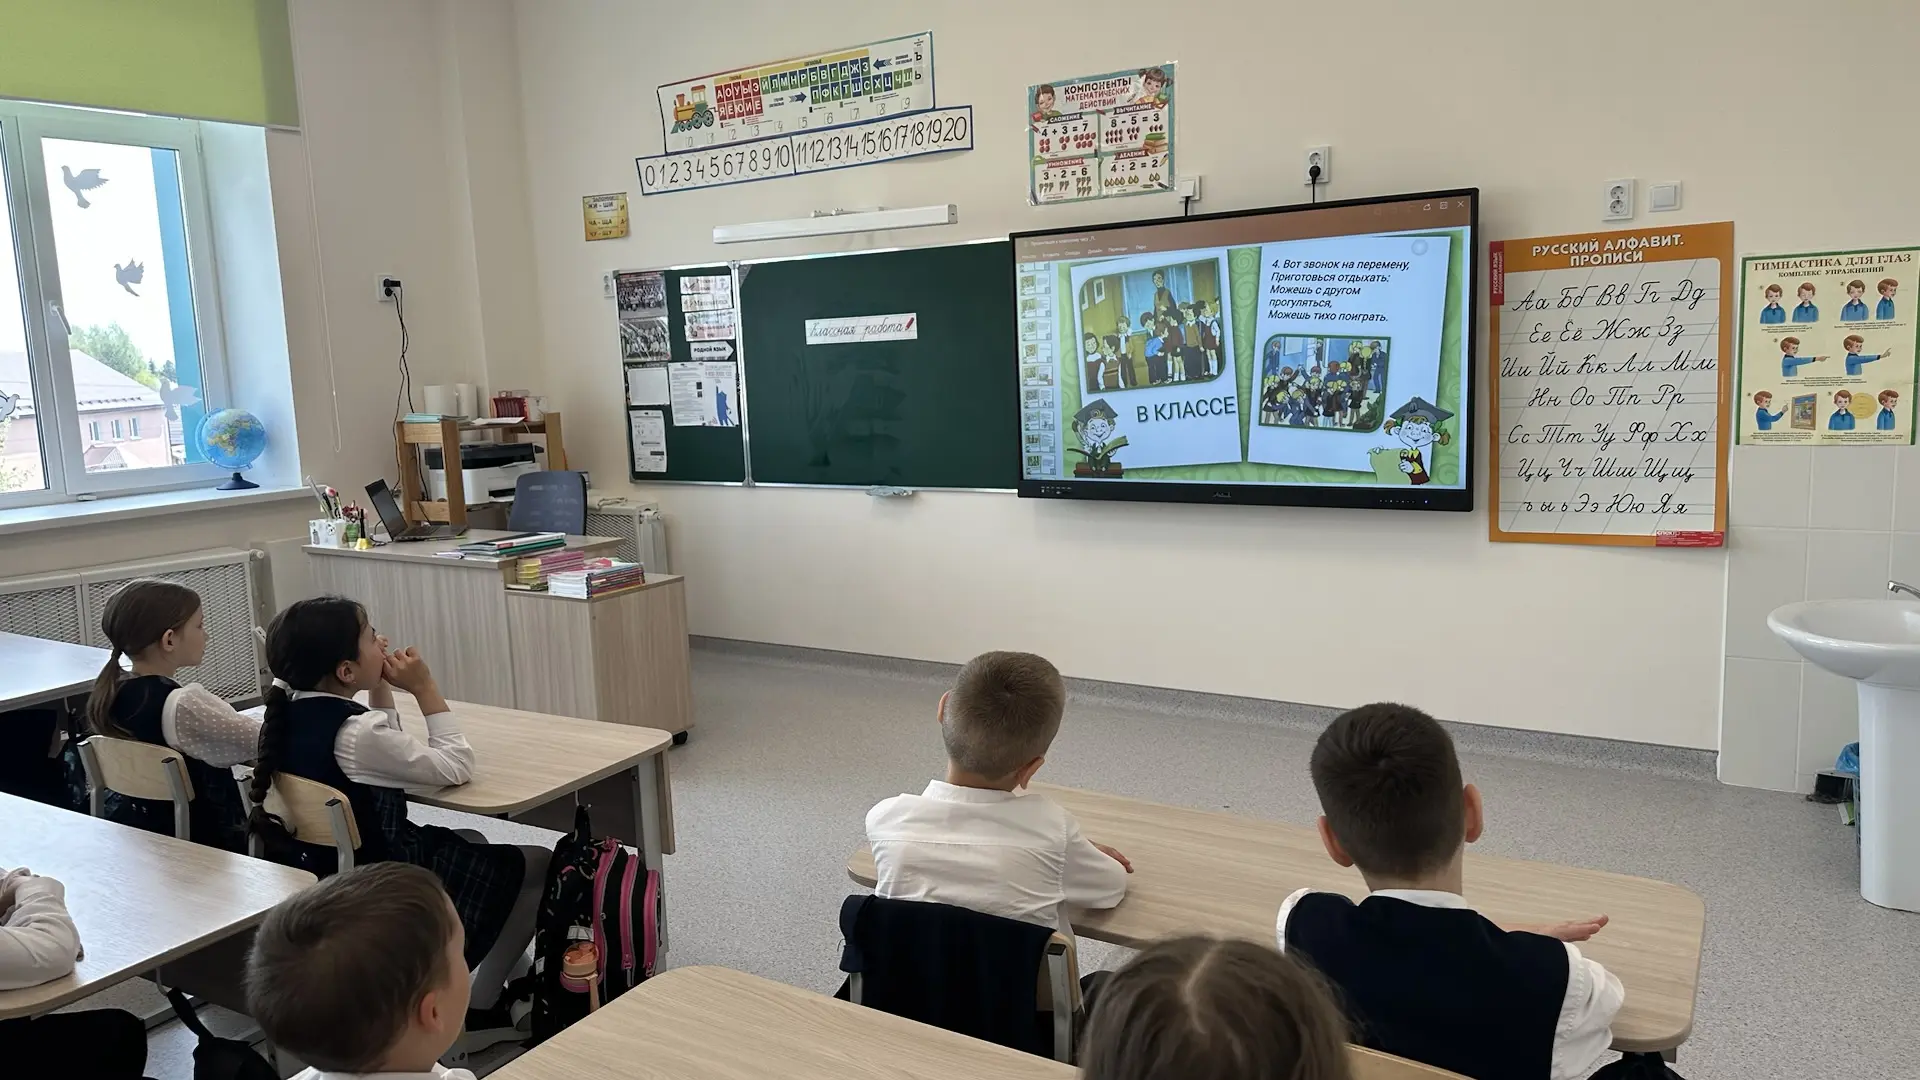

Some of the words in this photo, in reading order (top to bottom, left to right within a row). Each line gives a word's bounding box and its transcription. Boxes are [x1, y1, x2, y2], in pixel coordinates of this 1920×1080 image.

[717, 90, 723, 98] А
[725, 88, 732, 97] О
[734, 86, 740, 95] У
[743, 84, 750, 94] Ы
[753, 83, 759, 92] Э
[772, 79, 778, 89] Л
[781, 77, 788, 86] М
[790, 75, 797, 85] Н
[801, 74, 806, 83] Р
[810, 72, 817, 81] Б
[821, 70, 827, 79] В
[830, 68, 836, 77] Г
[842, 67, 849, 77] Д
[850, 64, 859, 74] Ж
[862, 62, 868, 72] З
[1065, 78, 1131, 95] КОМПОНЕНТЫ
[719, 107, 725, 116] Я
[736, 104, 743, 112] Ю
[746, 102, 752, 111] И
[755, 101, 761, 110] Е
[812, 90, 818, 100] П
[822, 88, 829, 97] Ф
[832, 87, 838, 96] К
[843, 85, 849, 94] Т
[864, 81, 870, 90] С
[875, 79, 881, 88] Х
[884, 77, 891, 88] Ц
[895, 74, 901, 84] Ч
[1066, 86, 1130, 102] МАТЕМАТИЧЕСКИХ
[1079, 98, 1116, 110] ДЕЙСТВИЙ
[1116, 104, 1152, 113] ВЫЧИТАНИЕ
[1050, 114, 1080, 122] СЛОЖЕНИЕ
[1111, 119, 1117, 127] 8
[1131, 116, 1137, 125] 5
[1154, 113, 1159, 121] 3
[1062, 126, 1067, 134] 3
[1083, 123, 1088, 131] 7
[646, 165, 655, 186] 0
[660, 164, 665, 184] 1
[670, 162, 678, 184] 2
[684, 160, 692, 181] 3
[696, 159, 705, 179] 4
[710, 156, 719, 178] 5
[724, 154, 733, 175] 6
[736, 152, 744, 174] 7
[749, 150, 757, 172] 8
[762, 148, 770, 170] 9
[775, 145, 790, 168] 10
[796, 141, 806, 165] 11
[809, 139, 824, 163] 12
[827, 136, 842, 160] 13
[844, 134, 858, 157] 14
[861, 130, 875, 155] 15
[878, 128, 891, 152] 16
[894, 124, 908, 150] 17
[910, 121, 924, 147] 18
[926, 118, 942, 144] 19
[943, 116, 967, 142] 20
[1119, 150, 1145, 158] ДЕЛЕНИЕ
[1048, 159, 1082, 167] УМНОЖЕНИЕ
[1111, 164, 1116, 172] 4
[1130, 162, 1135, 170] 2
[1152, 159, 1158, 168] 2
[1044, 172, 1049, 180] 3
[1061, 170, 1066, 178] 2
[1533, 238, 1599, 256] РУССКИЙ
[1604, 233, 1684, 250] АЛФАВИТ.
[1272, 260, 1280, 268] 4.
[1283, 259, 1302, 268] Вот
[1357, 261, 1410, 271] перемену,
[1570, 250, 1643, 266] ПРОПИСИ
[1754, 258, 1842, 270] ГИМНАСТИКА
[1846, 256, 1873, 266] ДЛЯ
[1877, 254, 1911, 264] ГЛАЗ
[1271, 272, 1336, 283] Приготовься
[1338, 274, 1390, 283] отдыхать:
[1778, 270, 1821, 278] КОМПЛЕКС
[1825, 266, 1884, 275] УПРАЖНЕНИЙ
[1270, 285, 1313, 294] Можешь
[1322, 287, 1361, 296] другом
[1512, 290, 1550, 311] Аа
[1557, 285, 1598, 308] Бб
[1596, 283, 1630, 306] Вв
[1634, 281, 1660, 304] Гг
[1671, 279, 1706, 310] Дд
[1269, 299, 1332, 308] прогуляться,
[1268, 310, 1310, 319] Можешь
[1314, 312, 1336, 320] тихо
[1338, 313, 1388, 323] поиграть.
[811, 322, 856, 337] Классная
[861, 317, 904, 340] работа
[1529, 322, 1551, 343] Ее
[1560, 319, 1582, 342] Ёё
[1592, 318, 1650, 340] Жж
[1658, 315, 1684, 346] Зз
[1501, 357, 1531, 378] Ии
[1539, 351, 1570, 376] Йй
[1577, 353, 1608, 375] Кк
[1613, 352, 1654, 373] Лл
[1661, 350, 1716, 371] Мм
[1528, 388, 1562, 407] Нн
[1570, 386, 1595, 406] Оо
[1603, 386, 1641, 406] Пп
[1652, 384, 1684, 411] Рр
[1137, 406, 1148, 422] В
[1154, 396, 1236, 421] КЛАССЕ
[1508, 424, 1530, 444] Сс
[1537, 424, 1584, 443] Тт
[1592, 423, 1616, 451] Уу
[1623, 421, 1658, 451] Фф
[1665, 421, 1707, 442] Хх
[1517, 458, 1552, 482] Цц
[1558, 458, 1585, 477] Чч
[1592, 457, 1637, 477] Шш
[1644, 458, 1694, 482] Щщ
[1524, 501, 1533, 511] ъ
[1541, 501, 1555, 511] ы
[1561, 501, 1568, 511] ь
[1574, 494, 1598, 513] Ээ
[1605, 494, 1644, 513] Юю
[1651, 493, 1687, 514] Яя
